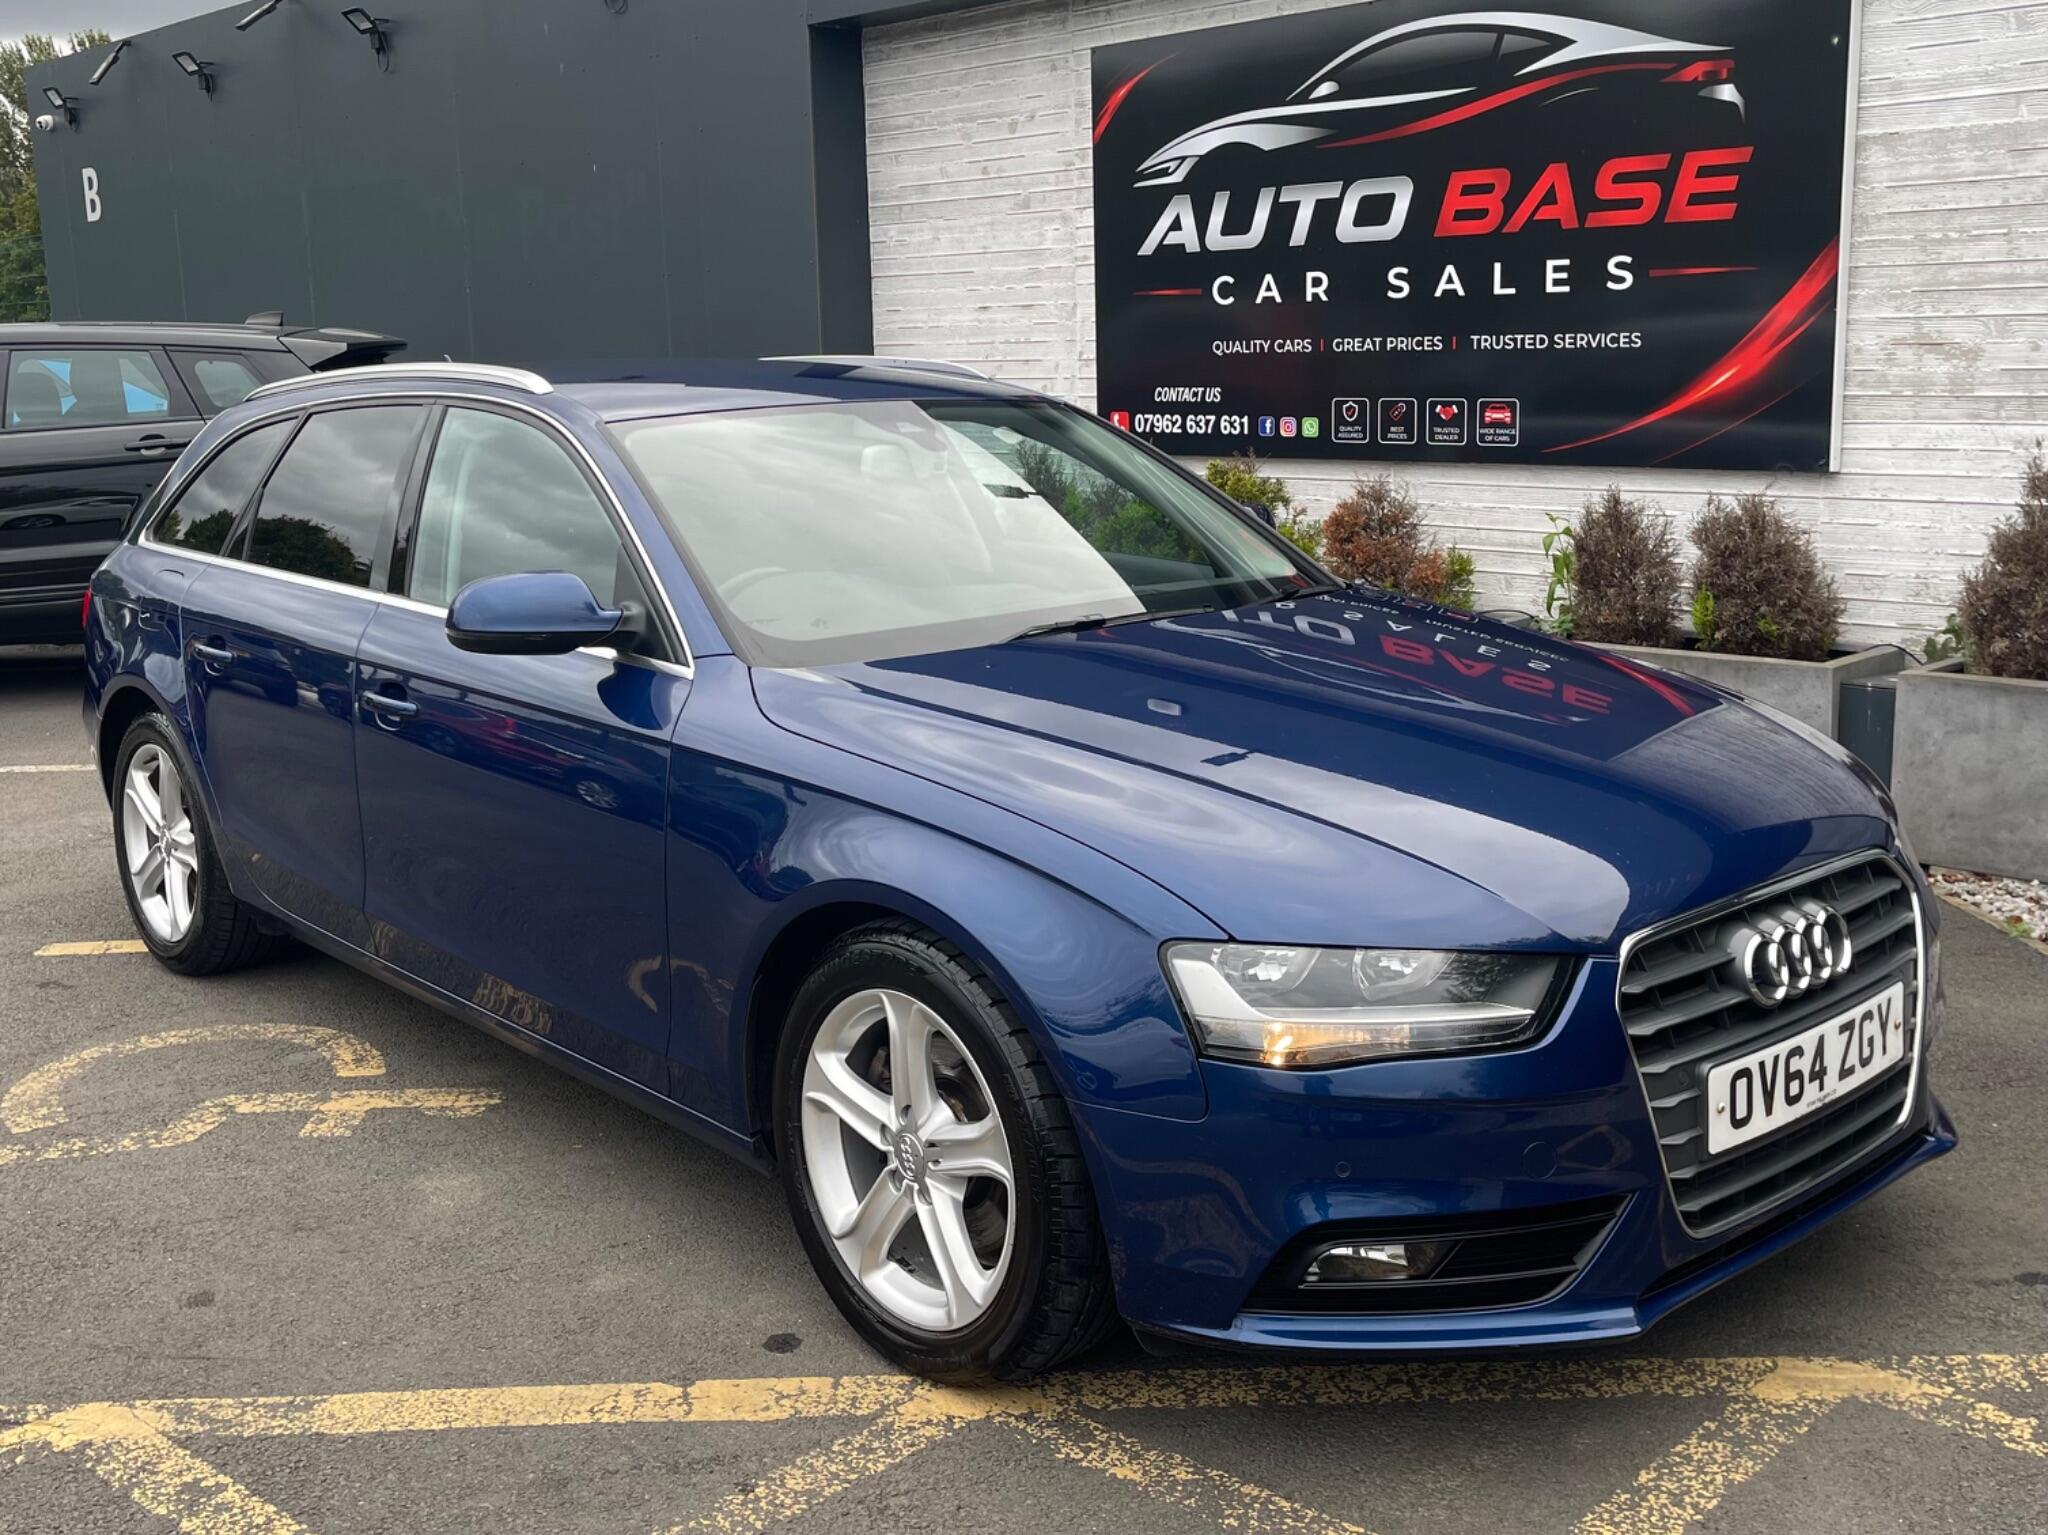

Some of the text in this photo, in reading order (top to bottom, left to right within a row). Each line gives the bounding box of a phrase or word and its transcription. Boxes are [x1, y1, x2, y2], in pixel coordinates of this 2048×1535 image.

[82, 167, 102, 222] B
[1137, 146, 1755, 255] AUTO BASE
[1211, 255, 1635, 305] CAR SALES
[1212, 339, 1312, 356] QUALITY CARS
[1332, 336, 1443, 352] GREAT PRICES
[1470, 332, 1642, 350] TRUSTED SERVICES
[1154, 386, 1222, 403] CONTACT US
[1134, 413, 1249, 435] 07962 637 631
[1729, 996, 1893, 1130] OV64 ZGY
